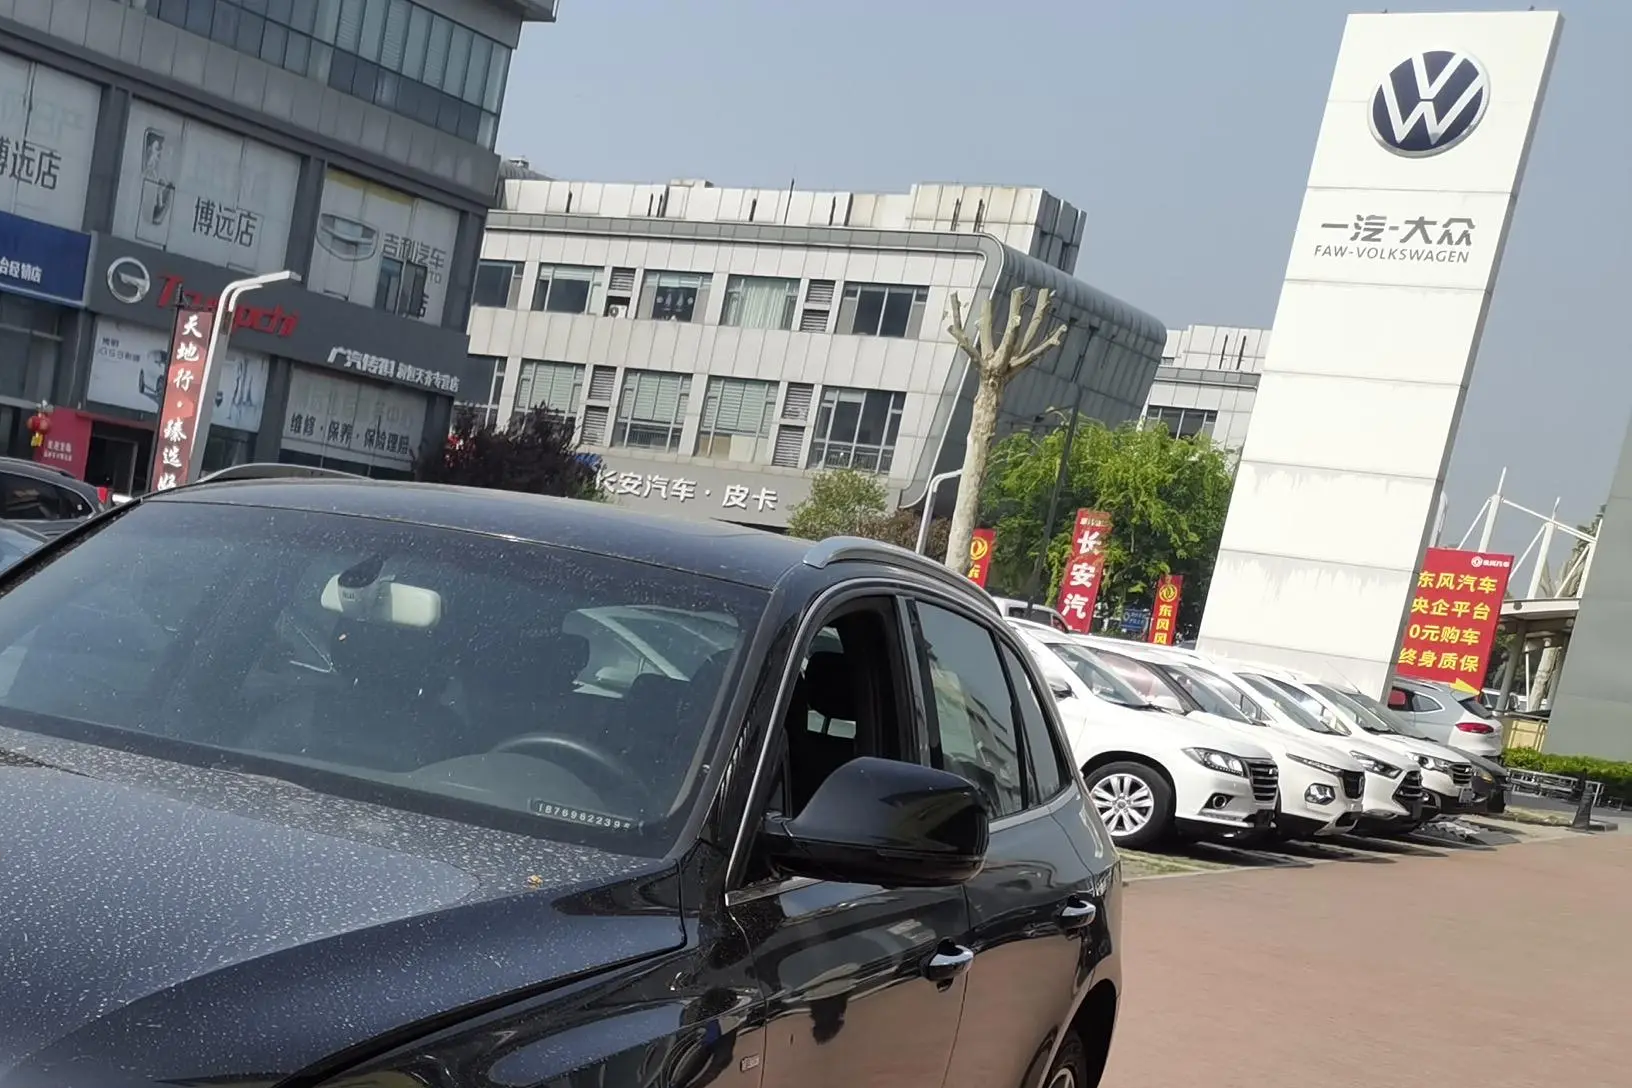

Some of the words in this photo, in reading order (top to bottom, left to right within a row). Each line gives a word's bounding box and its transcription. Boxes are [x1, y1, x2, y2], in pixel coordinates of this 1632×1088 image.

[192, 196, 258, 248] 博远店
[382, 232, 446, 270] 吉利汽车
[1314, 244, 1469, 263] FAW-VOLKSWAGEN
[1417, 570, 1498, 594] 东风汽车
[1410, 596, 1490, 620] 央企平台
[1409, 624, 1480, 645] 0元购车
[1398, 648, 1479, 673] 终身质保
